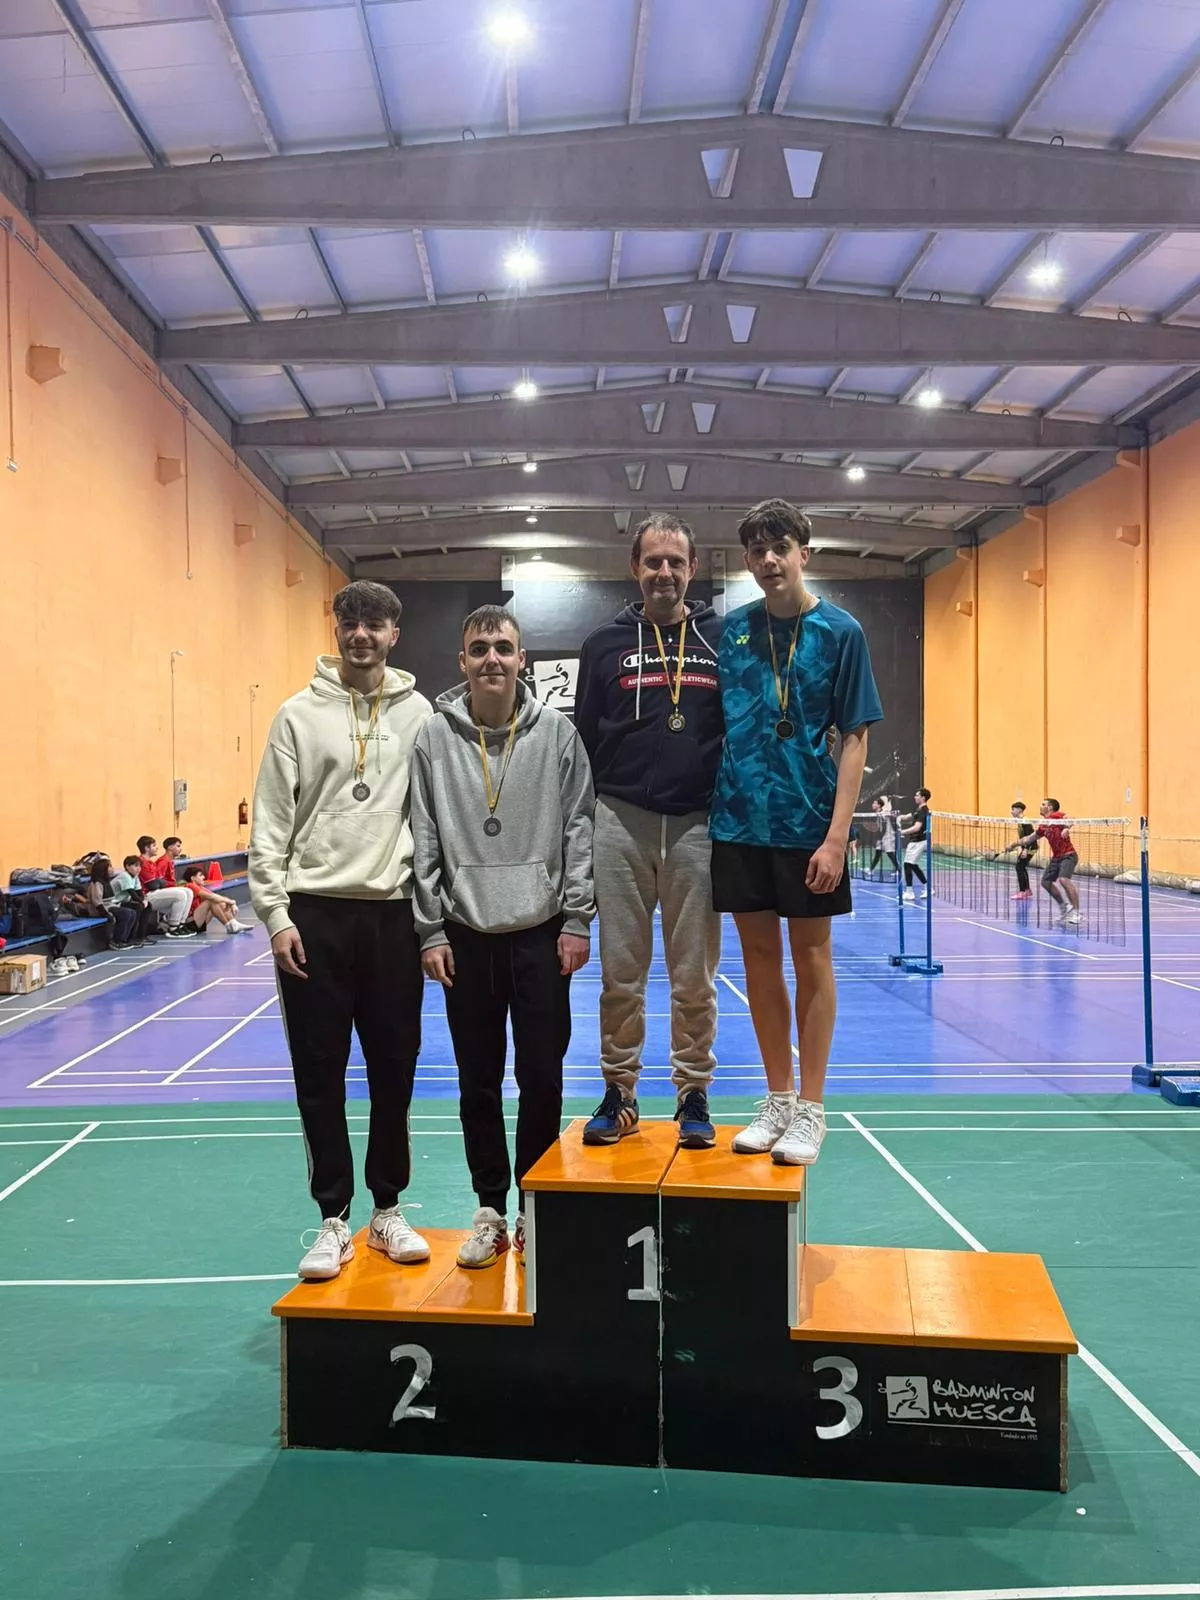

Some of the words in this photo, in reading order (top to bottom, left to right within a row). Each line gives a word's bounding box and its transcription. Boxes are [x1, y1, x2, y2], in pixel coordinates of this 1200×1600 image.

[623, 653, 717, 668] Champion
[673, 675, 718, 687] AHLETICWEAR
[627, 1225, 661, 1301] 1
[390, 1343, 436, 1422] 2
[813, 1355, 863, 1440] 3
[933, 1400, 1036, 1427] HUESCA
